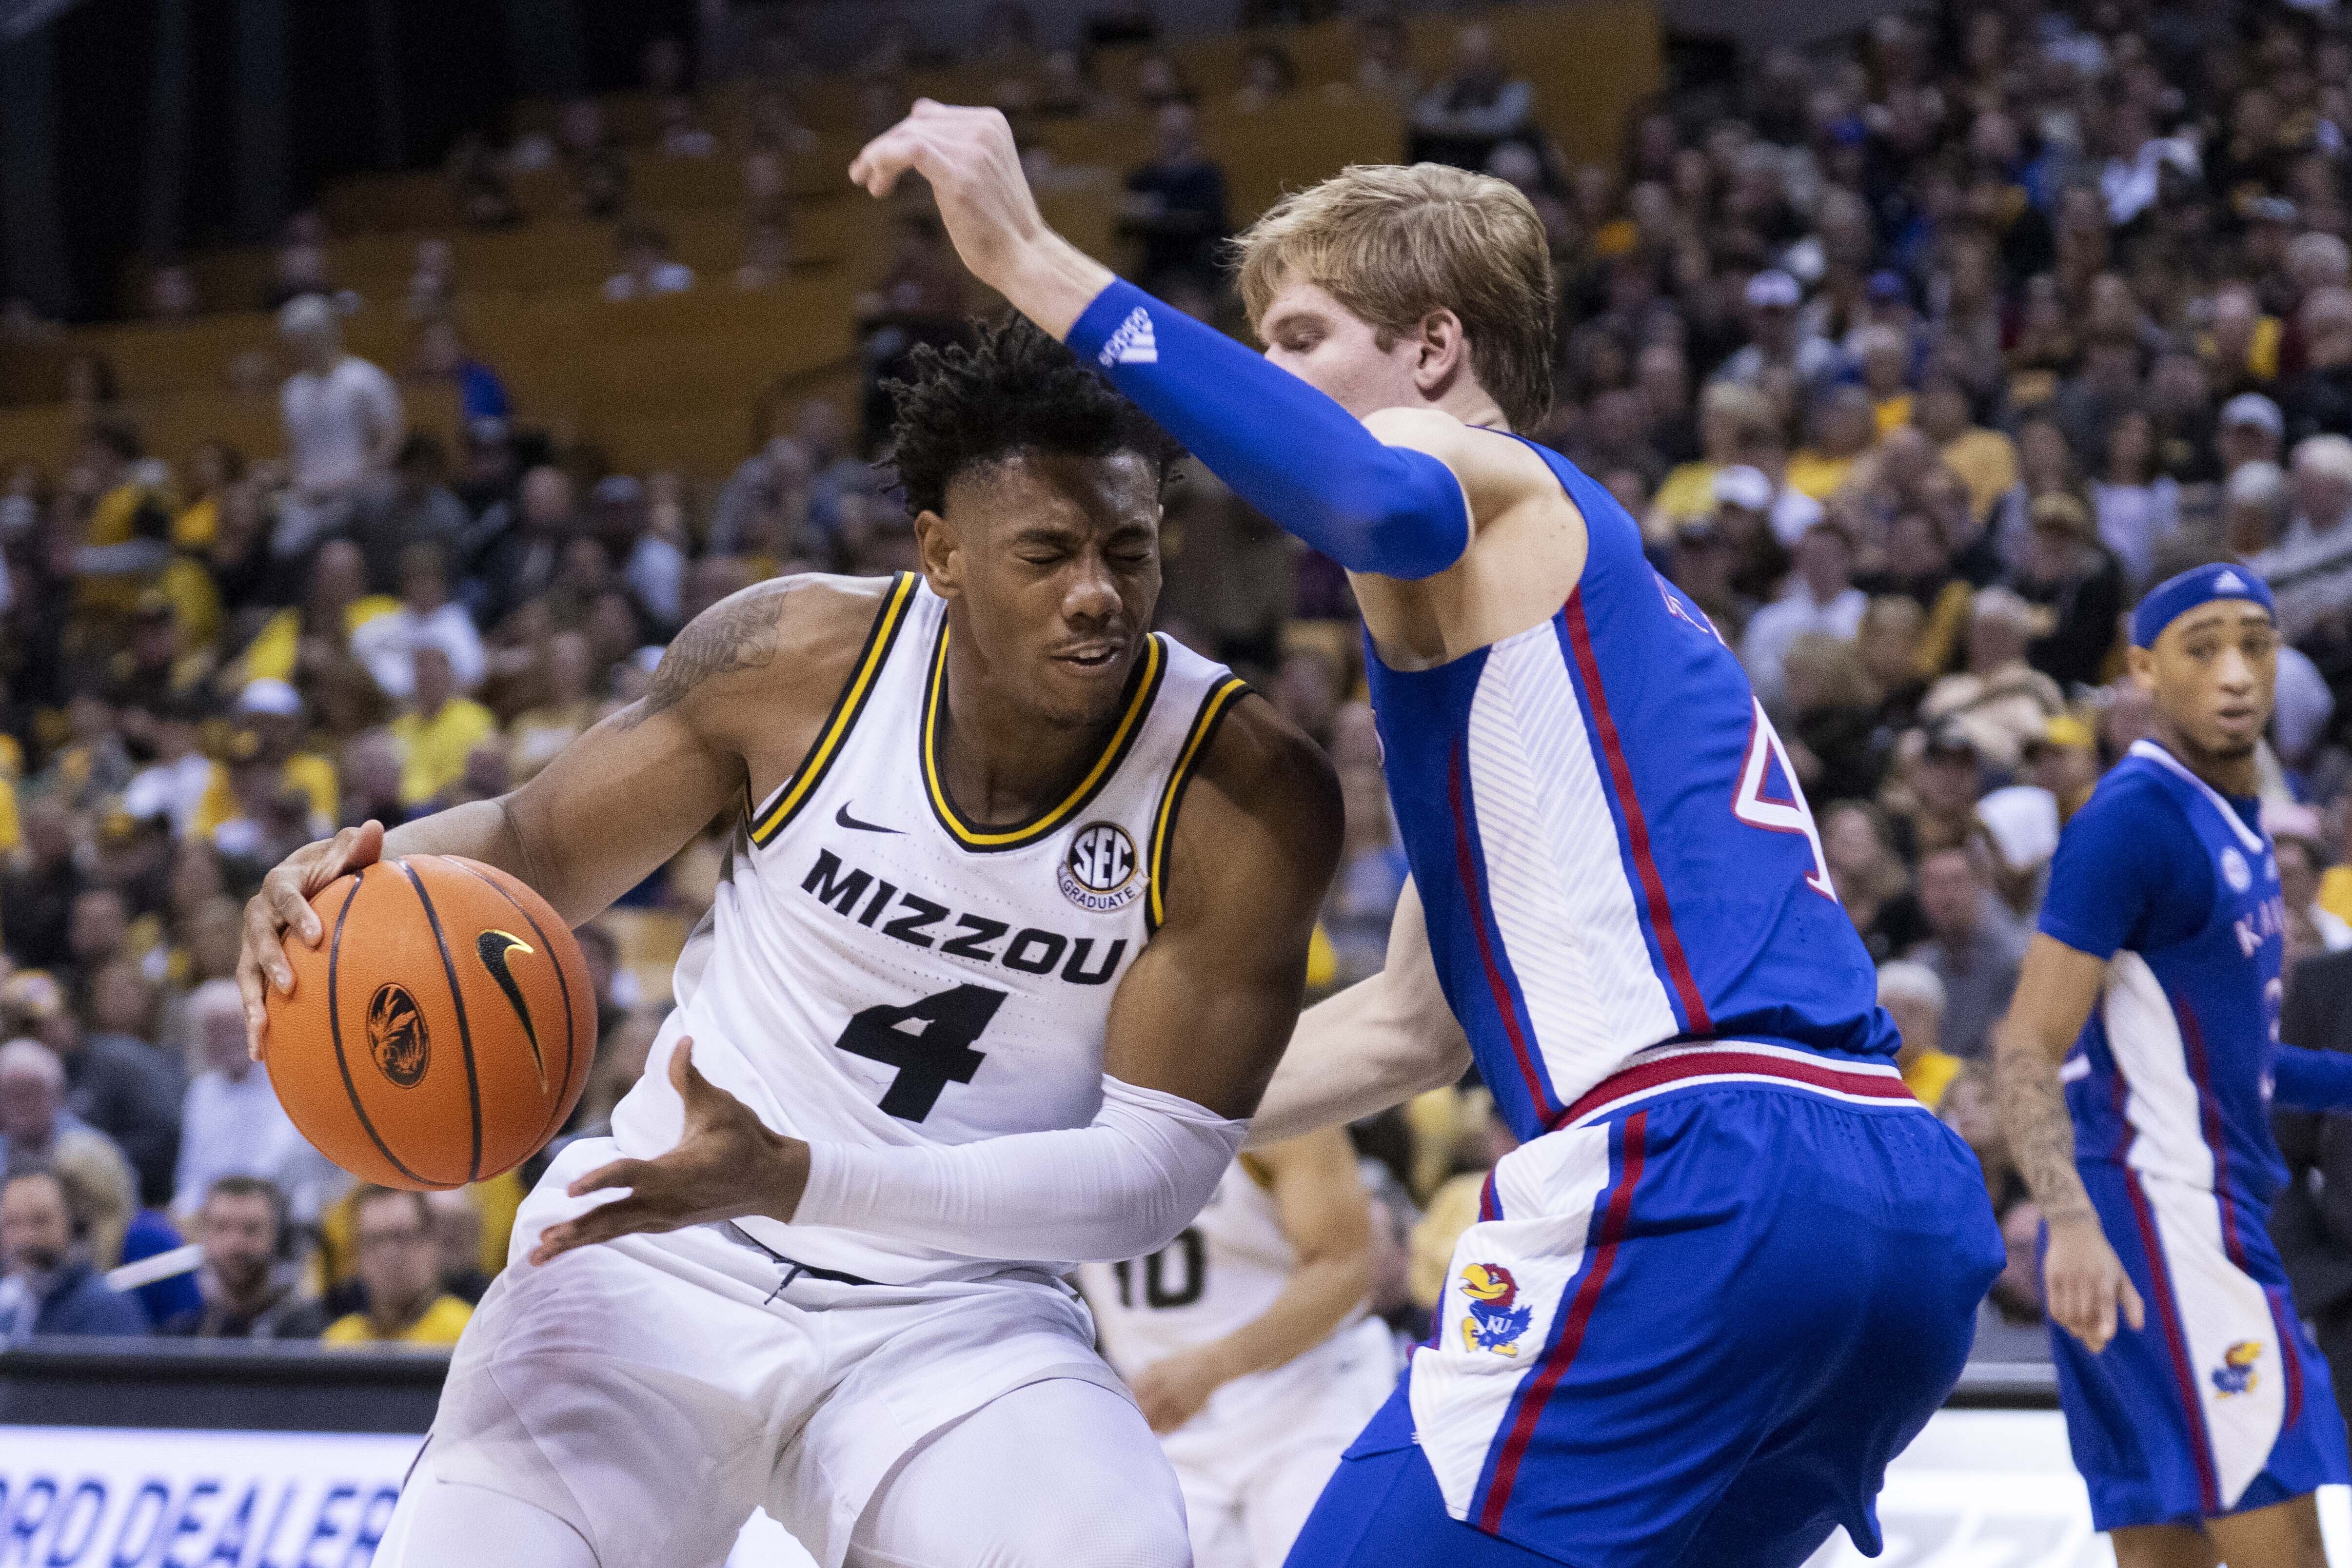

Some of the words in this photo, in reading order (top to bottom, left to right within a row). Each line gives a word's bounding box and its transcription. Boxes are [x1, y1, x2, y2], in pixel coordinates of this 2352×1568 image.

[1063, 879, 1135, 909] GRADUATE
[1073, 827, 1132, 889] SEC
[801, 847, 1128, 985] MIZZOU
[835, 983, 1009, 1123] 4
[1486, 1314, 1513, 1335] KU
[0, 1477, 106, 1567] RD
